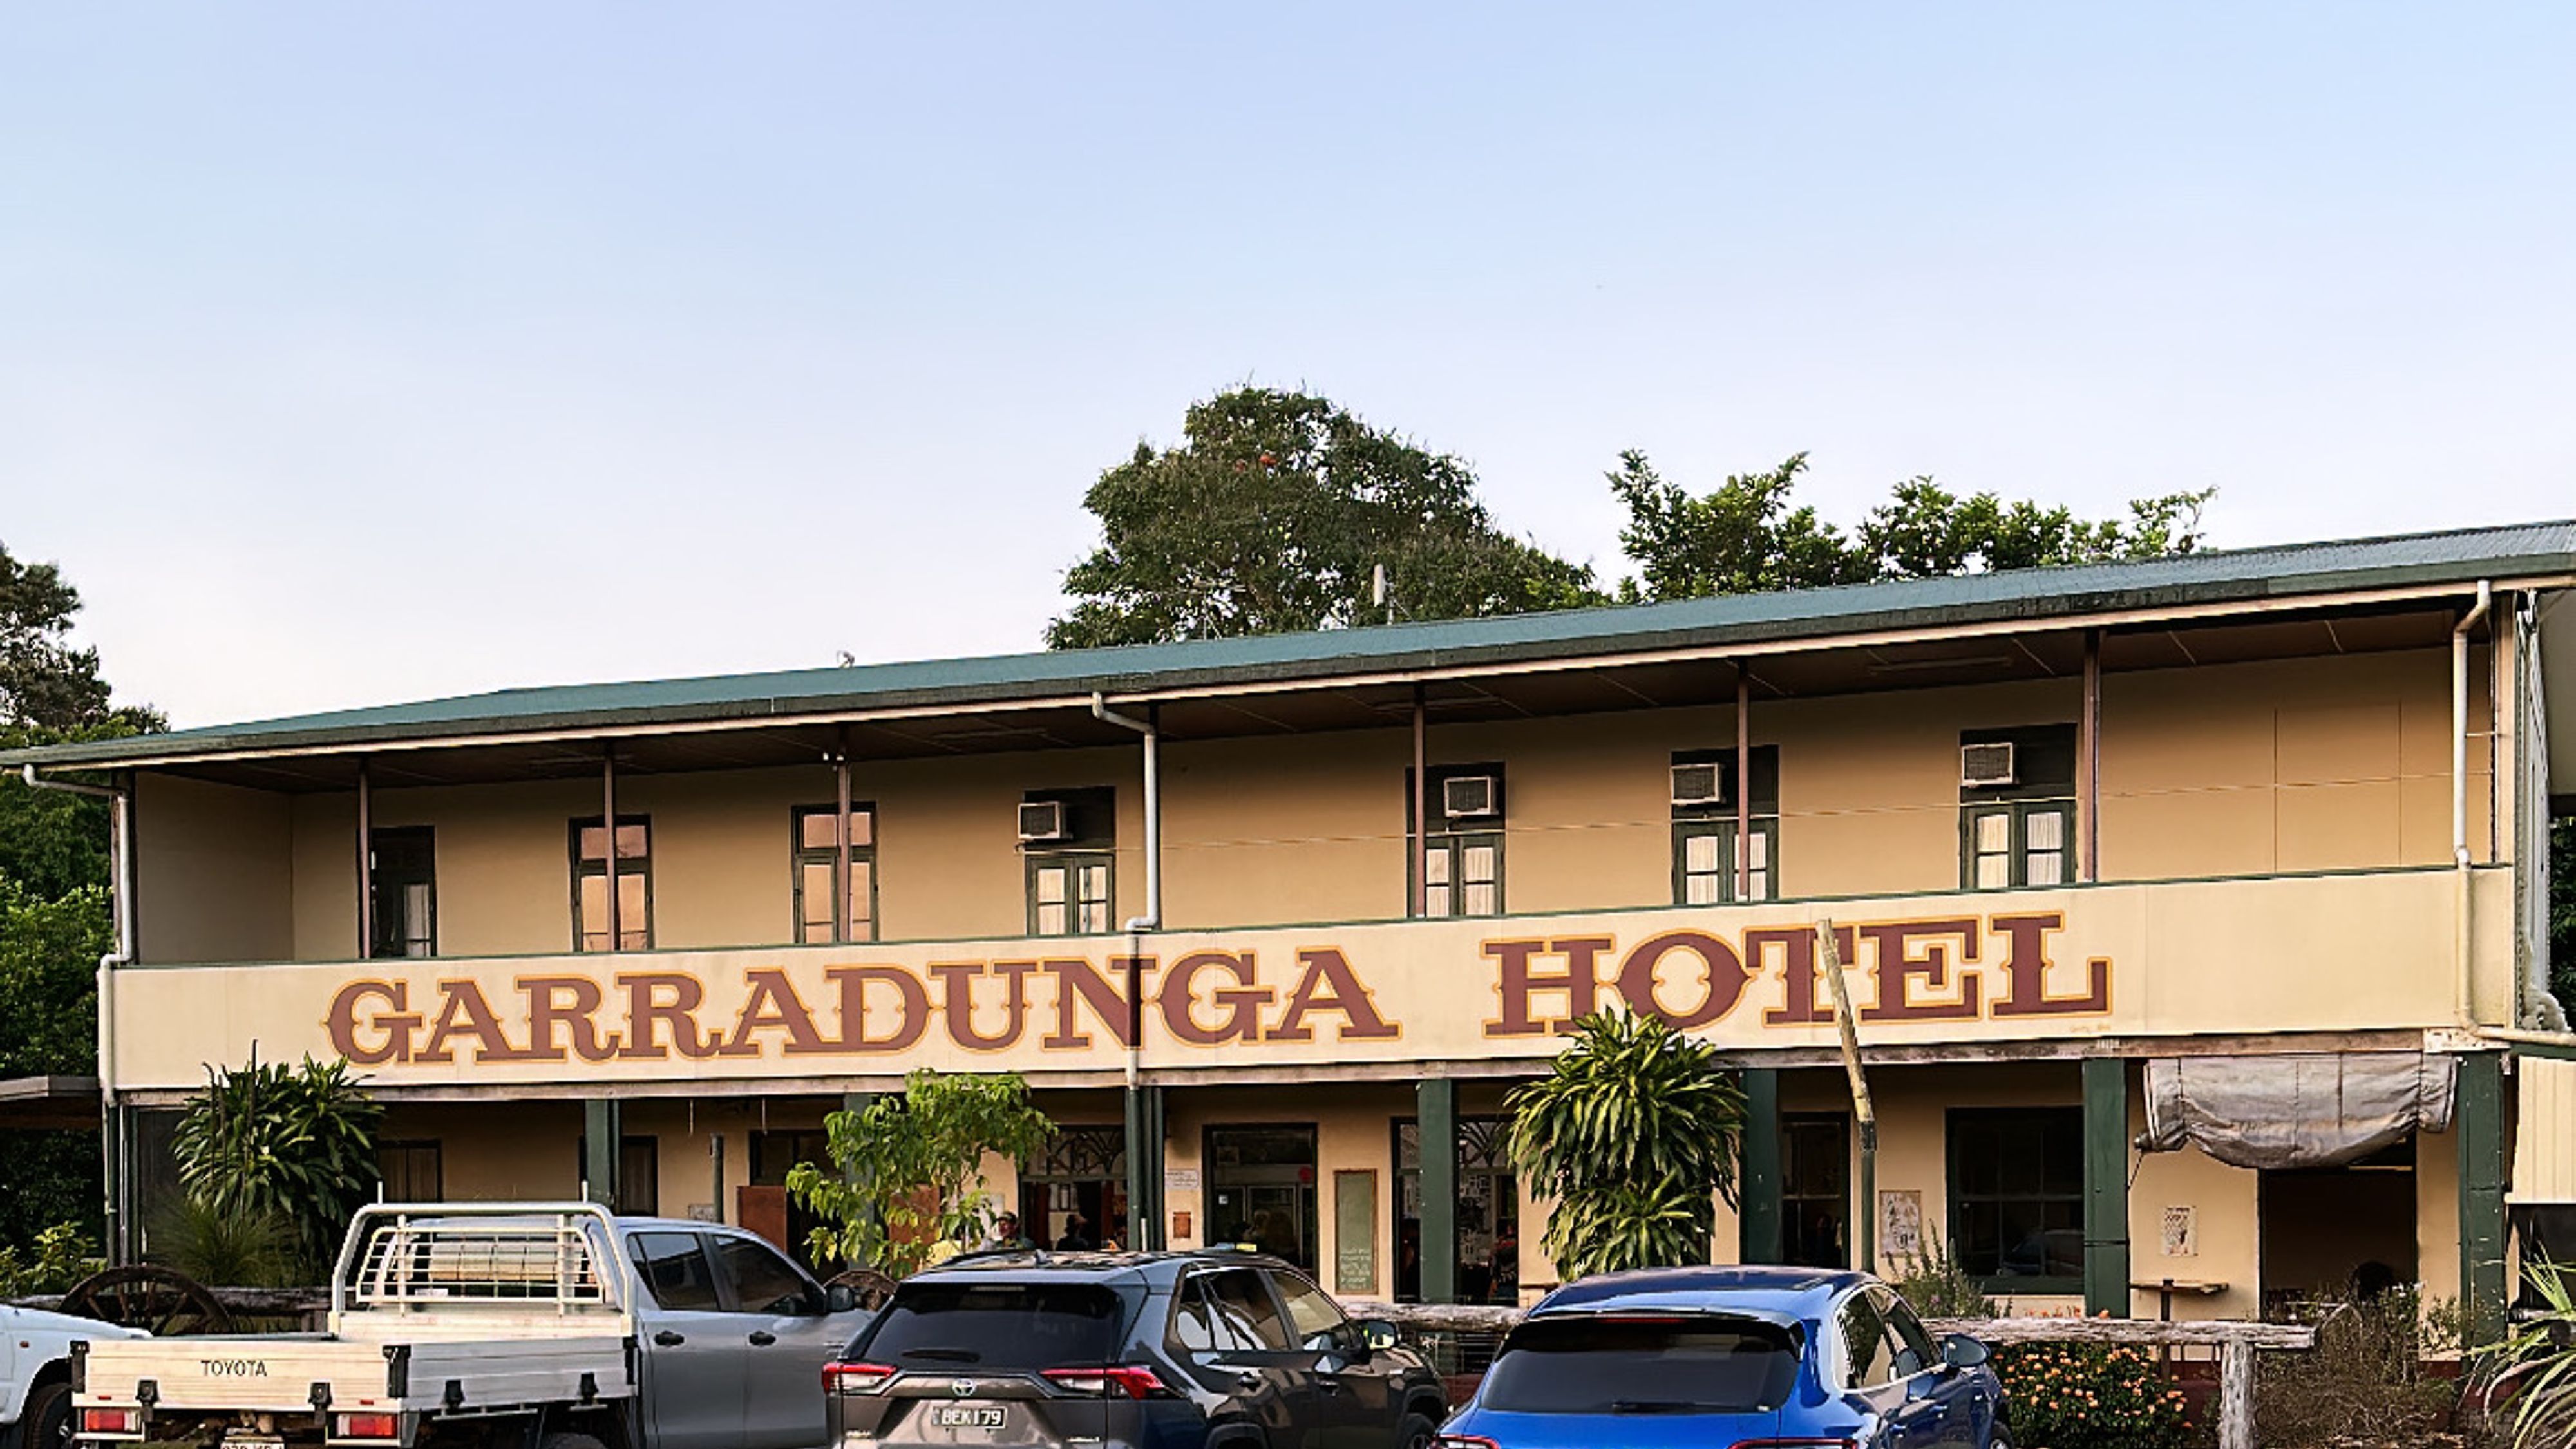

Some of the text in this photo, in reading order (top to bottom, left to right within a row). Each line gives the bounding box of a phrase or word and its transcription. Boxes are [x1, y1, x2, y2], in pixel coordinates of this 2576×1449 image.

[320, 910, 2114, 1066] GARRADUNGA HOTEL
[200, 1359, 268, 1377] TOYOTA
